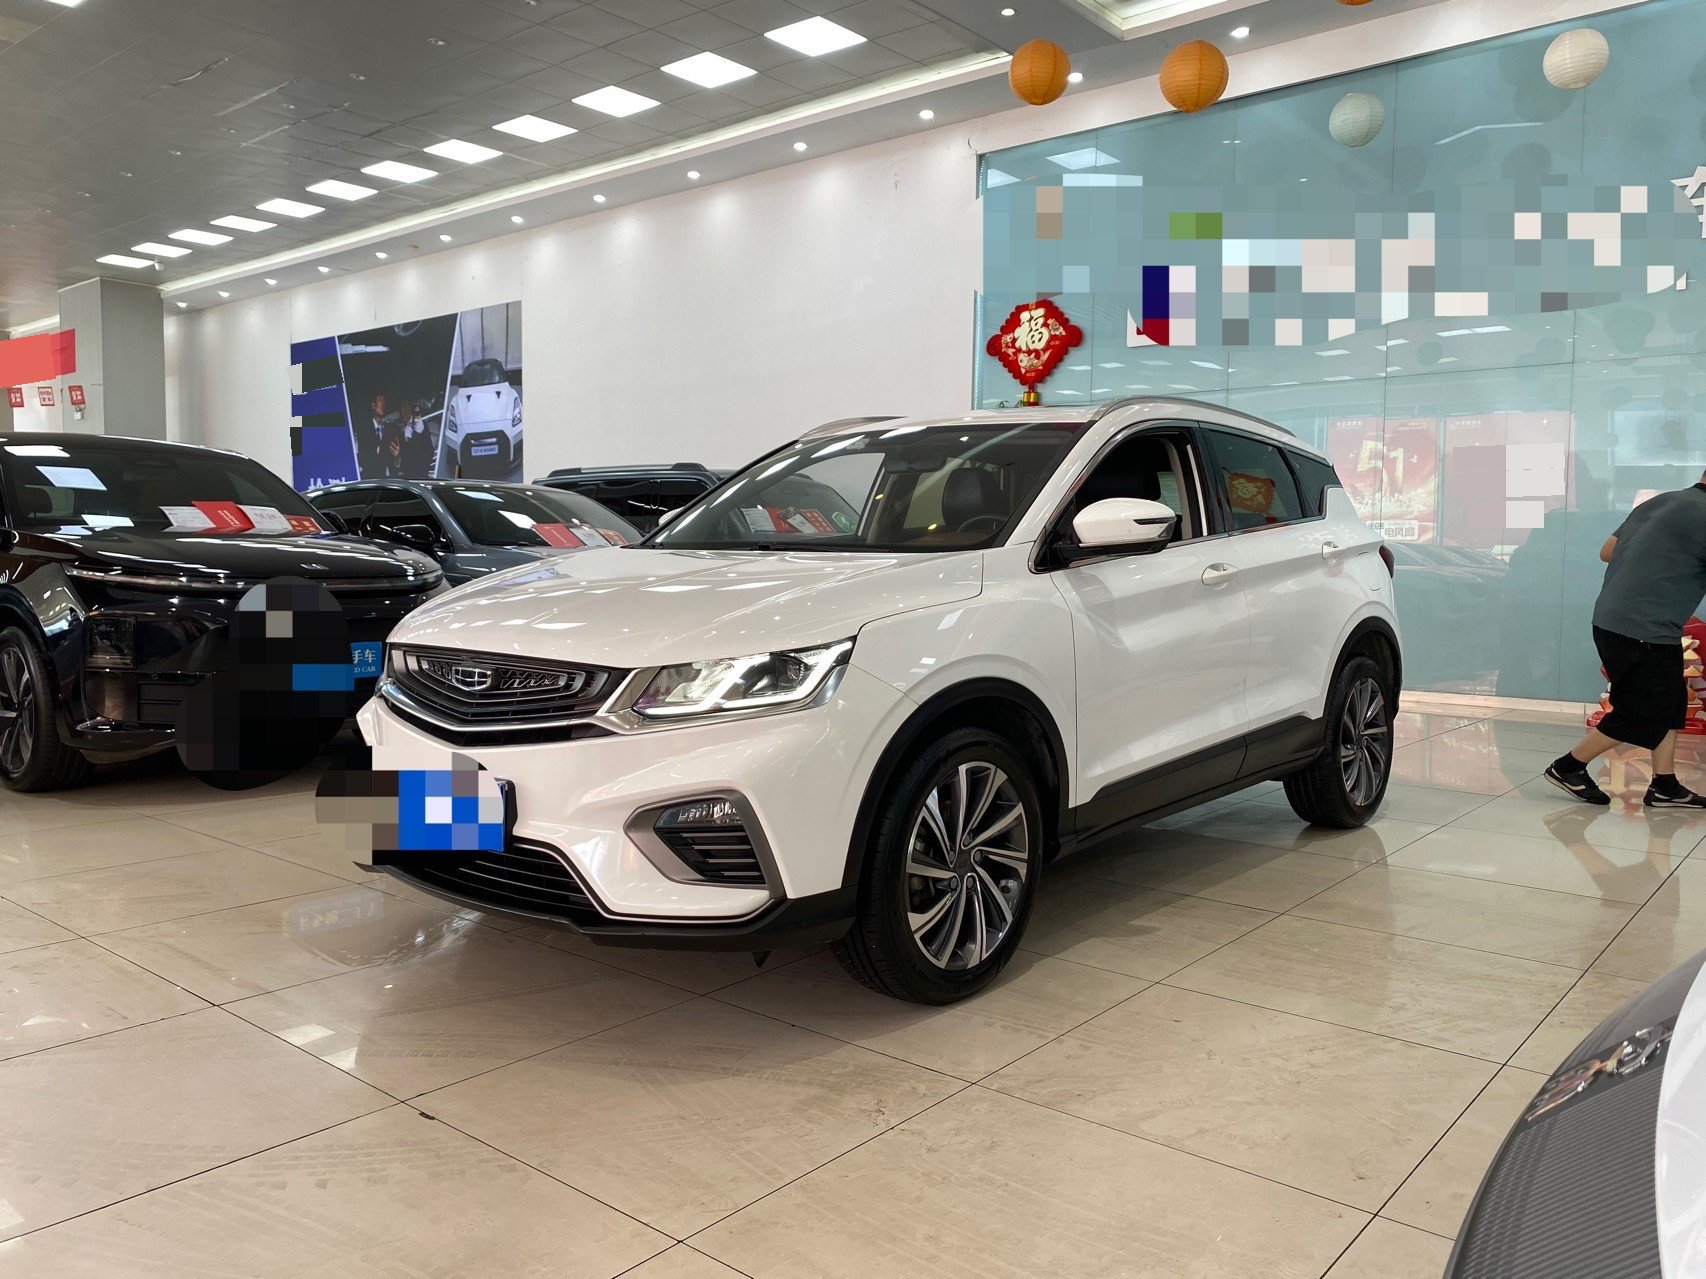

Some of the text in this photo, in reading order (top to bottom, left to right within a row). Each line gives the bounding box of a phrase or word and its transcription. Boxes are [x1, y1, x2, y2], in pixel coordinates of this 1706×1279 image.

[1014, 307, 1050, 351] 福
[1385, 527, 1415, 538] 电风扇
[352, 649, 376, 664] 手车
